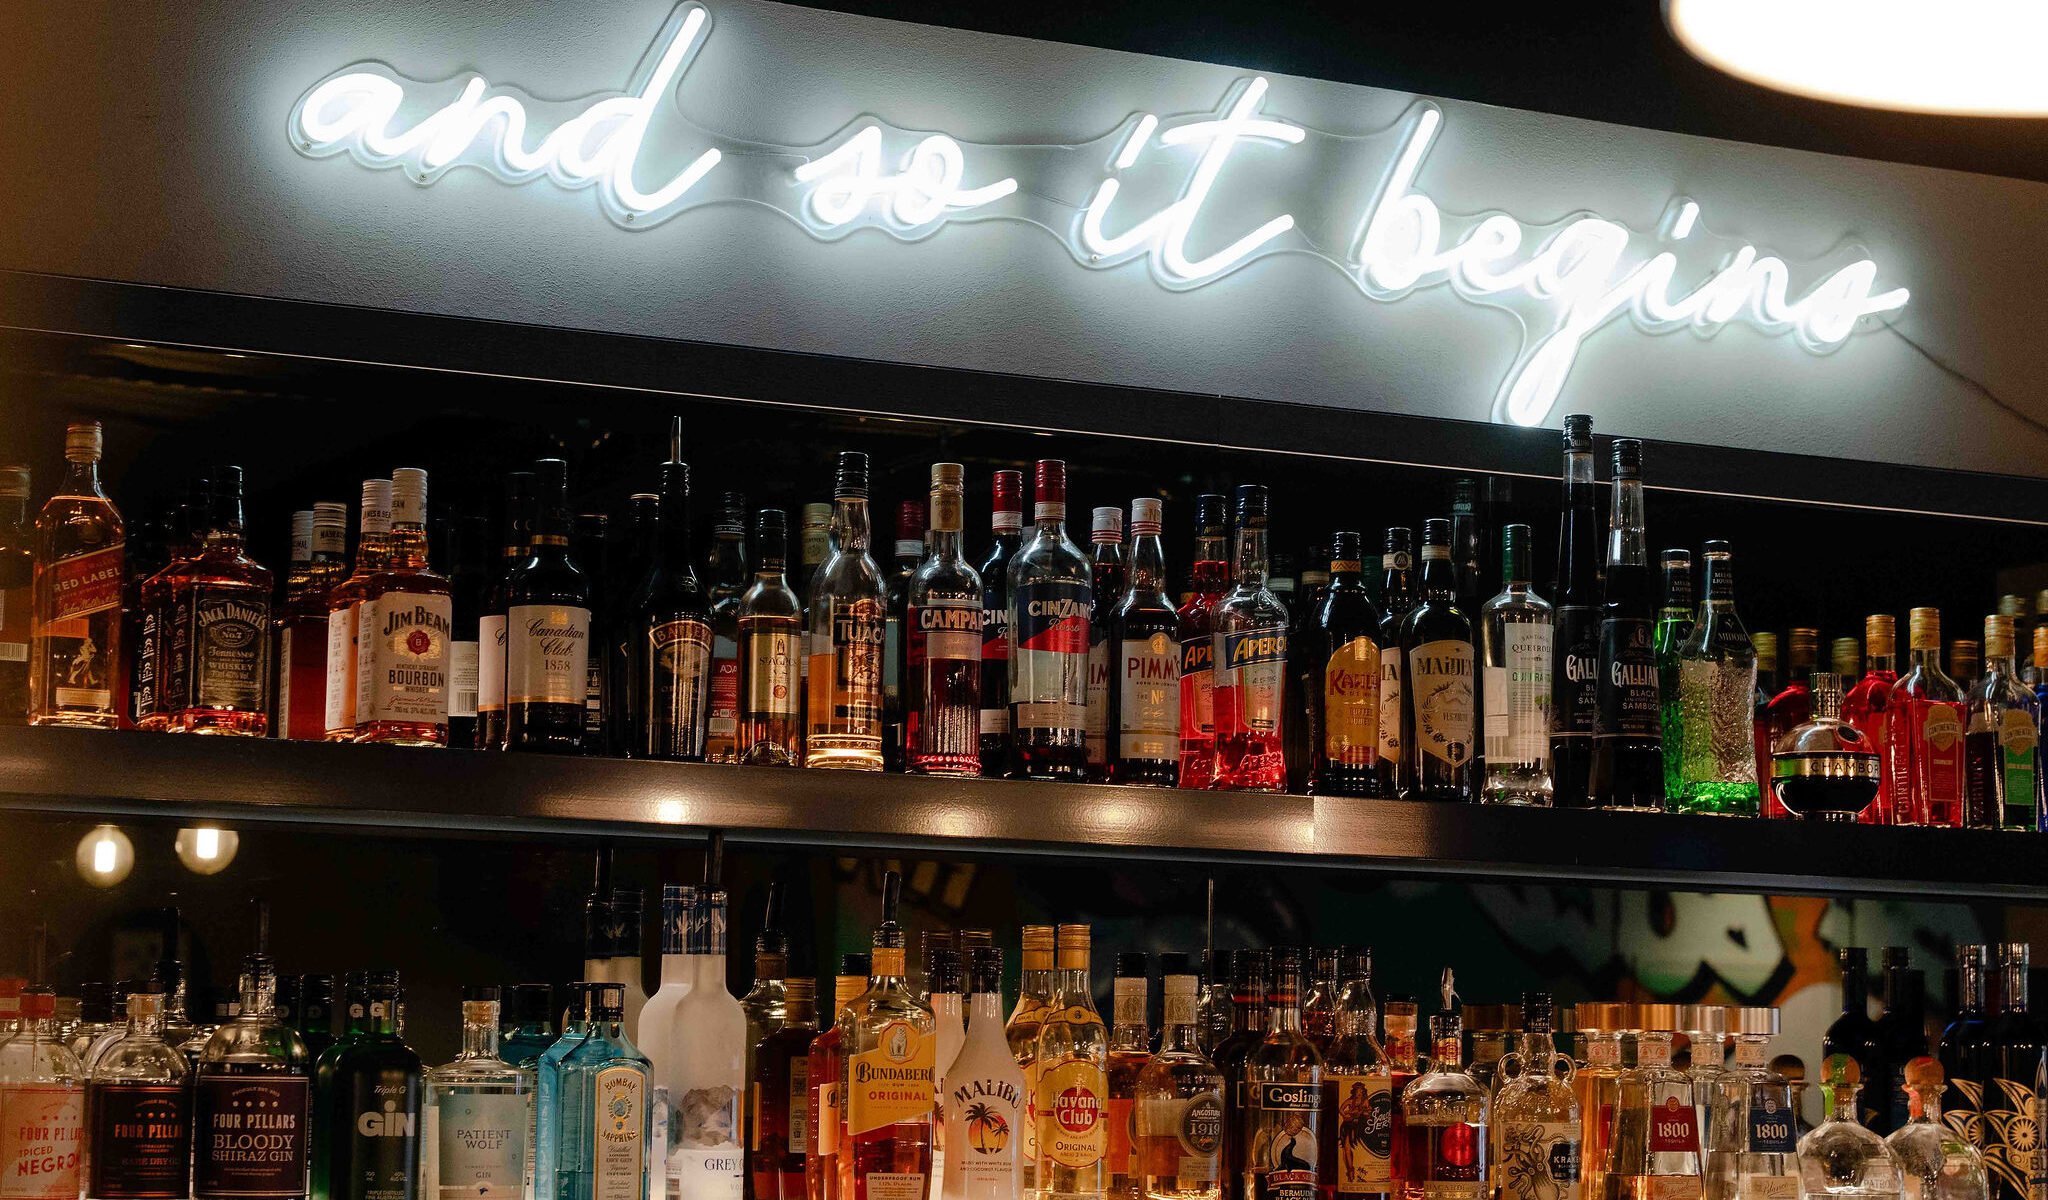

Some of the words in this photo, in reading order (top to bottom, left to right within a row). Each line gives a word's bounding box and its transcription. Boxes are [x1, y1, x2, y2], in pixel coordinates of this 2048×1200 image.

[301, 6, 722, 212] and
[796, 125, 1018, 226] so
[1082, 76, 1305, 281] it
[1361, 108, 1911, 427] begins
[54, 578, 79, 593] RED
[82, 567, 120, 584] LABEL
[198, 606, 226, 627] JACK
[383, 610, 413, 637] JIM
[414, 605, 450, 640] BEAM
[526, 618, 585, 640] Canadian
[836, 619, 885, 644] TUACA
[1233, 635, 1287, 662] APEROL
[208, 661, 253, 671] WHISKEY
[545, 659, 571, 672] 1858
[1127, 654, 1181, 682] PIMM'S
[388, 669, 445, 688] BOURBON
[1630, 689, 1655, 697] BLACK
[604, 1077, 638, 1091] BOMBAY
[868, 1090, 928, 1101] ORIGINAL
[1050, 1091, 1103, 1110] Havana
[213, 1113, 241, 1129] FOUR
[246, 1113, 296, 1129] PILLARS
[1059, 1109, 1094, 1126] Club
[20, 1127, 49, 1141] FOUR
[114, 1124, 144, 1138] FOUR
[457, 1129, 512, 1140] PATIENT
[601, 1127, 639, 1143] SAPPHIRE
[1657, 1121, 1690, 1138] 1800
[1755, 1123, 1788, 1140] 1800
[212, 1134, 295, 1150] BLOODY
[465, 1139, 503, 1150] WOLF
[1055, 1141, 1096, 1152] ORIGINAL
[211, 1149, 267, 1162] SHIRAZ
[269, 1150, 294, 1162] GIN
[704, 1158, 736, 1171] GREY
[475, 1171, 491, 1179] GIN
